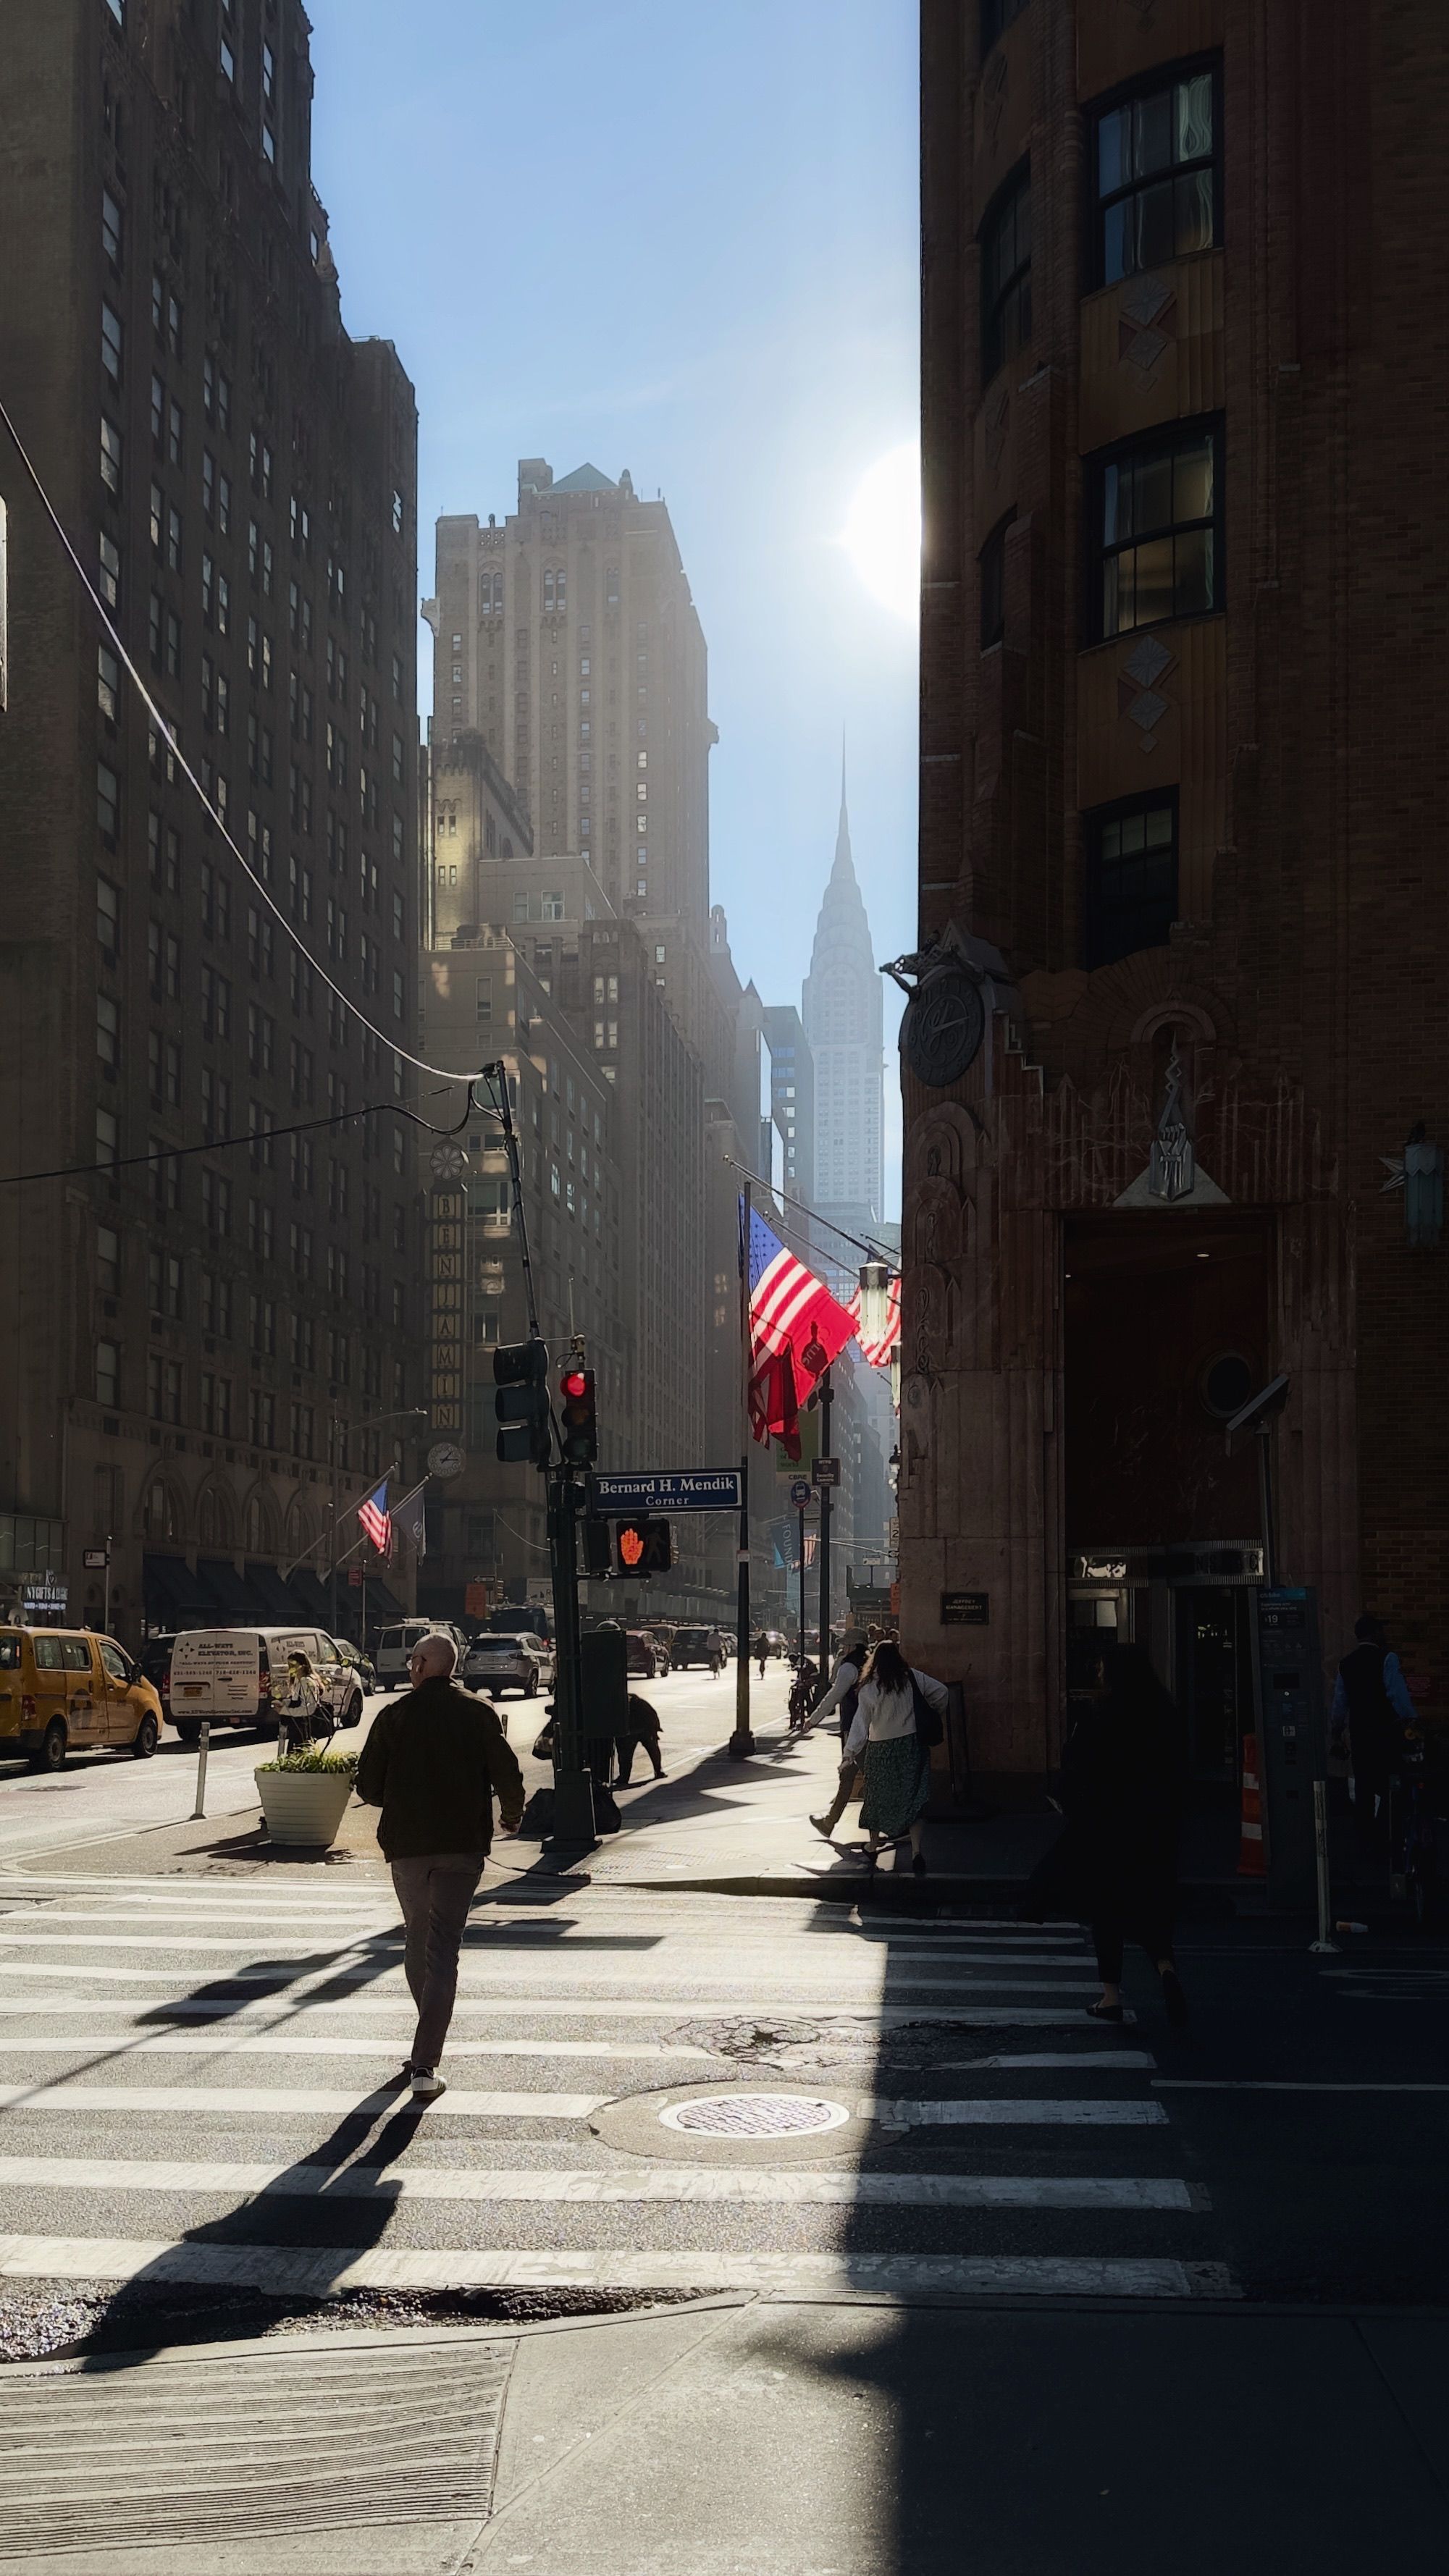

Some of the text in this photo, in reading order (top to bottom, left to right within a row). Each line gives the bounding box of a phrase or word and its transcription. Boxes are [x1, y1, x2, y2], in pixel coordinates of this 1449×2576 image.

[439, 1198, 453, 1425] BENJAMIN
[599, 1477, 734, 1494] Bernard H. Mendik
[645, 1496, 689, 1506] Corner
